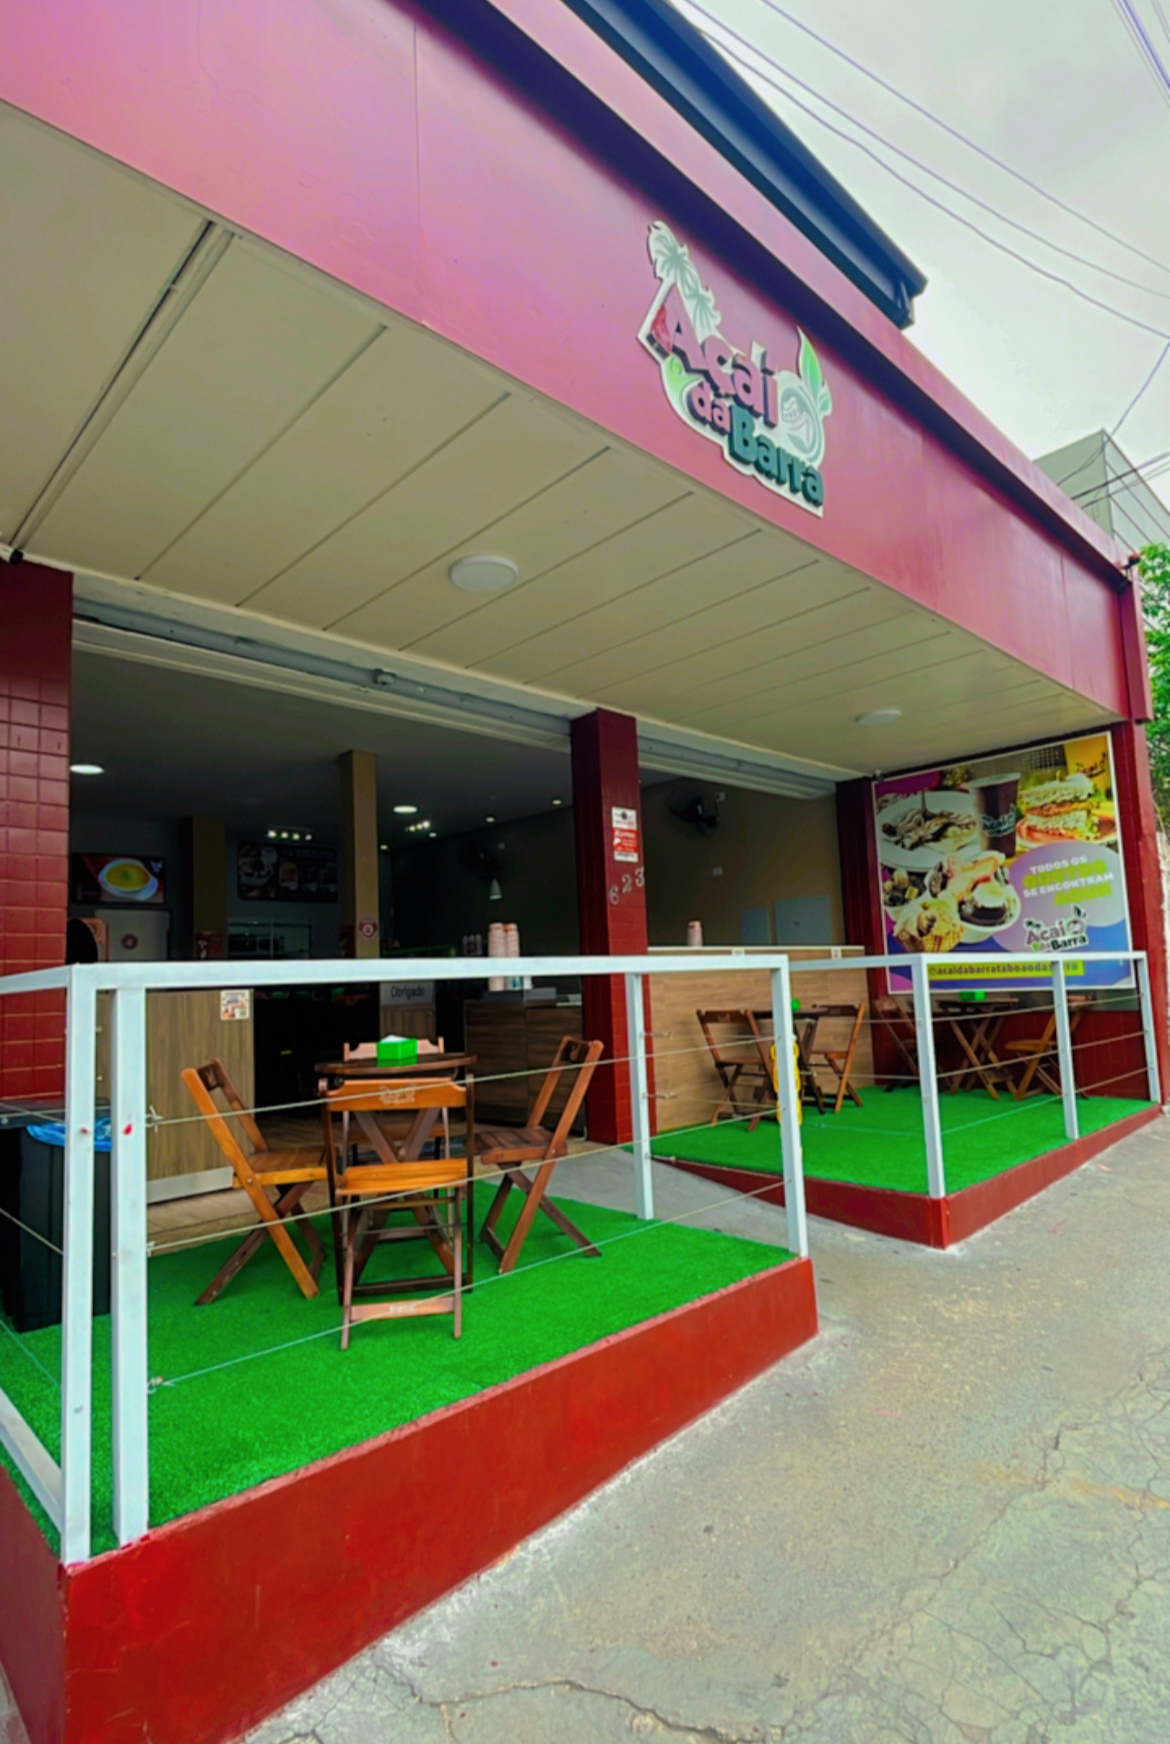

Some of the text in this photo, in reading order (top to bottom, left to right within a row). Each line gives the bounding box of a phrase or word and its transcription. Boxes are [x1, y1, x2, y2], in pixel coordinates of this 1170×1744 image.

[687, 384, 824, 506] da Barra
[1030, 855, 1088, 874] TODOS OS
[609, 868, 645, 905] 623
[1023, 872, 1113, 899] SE ENCONTRAM
[1051, 936, 1086, 950] Barra
[390, 985, 425, 1000] Obrigado
